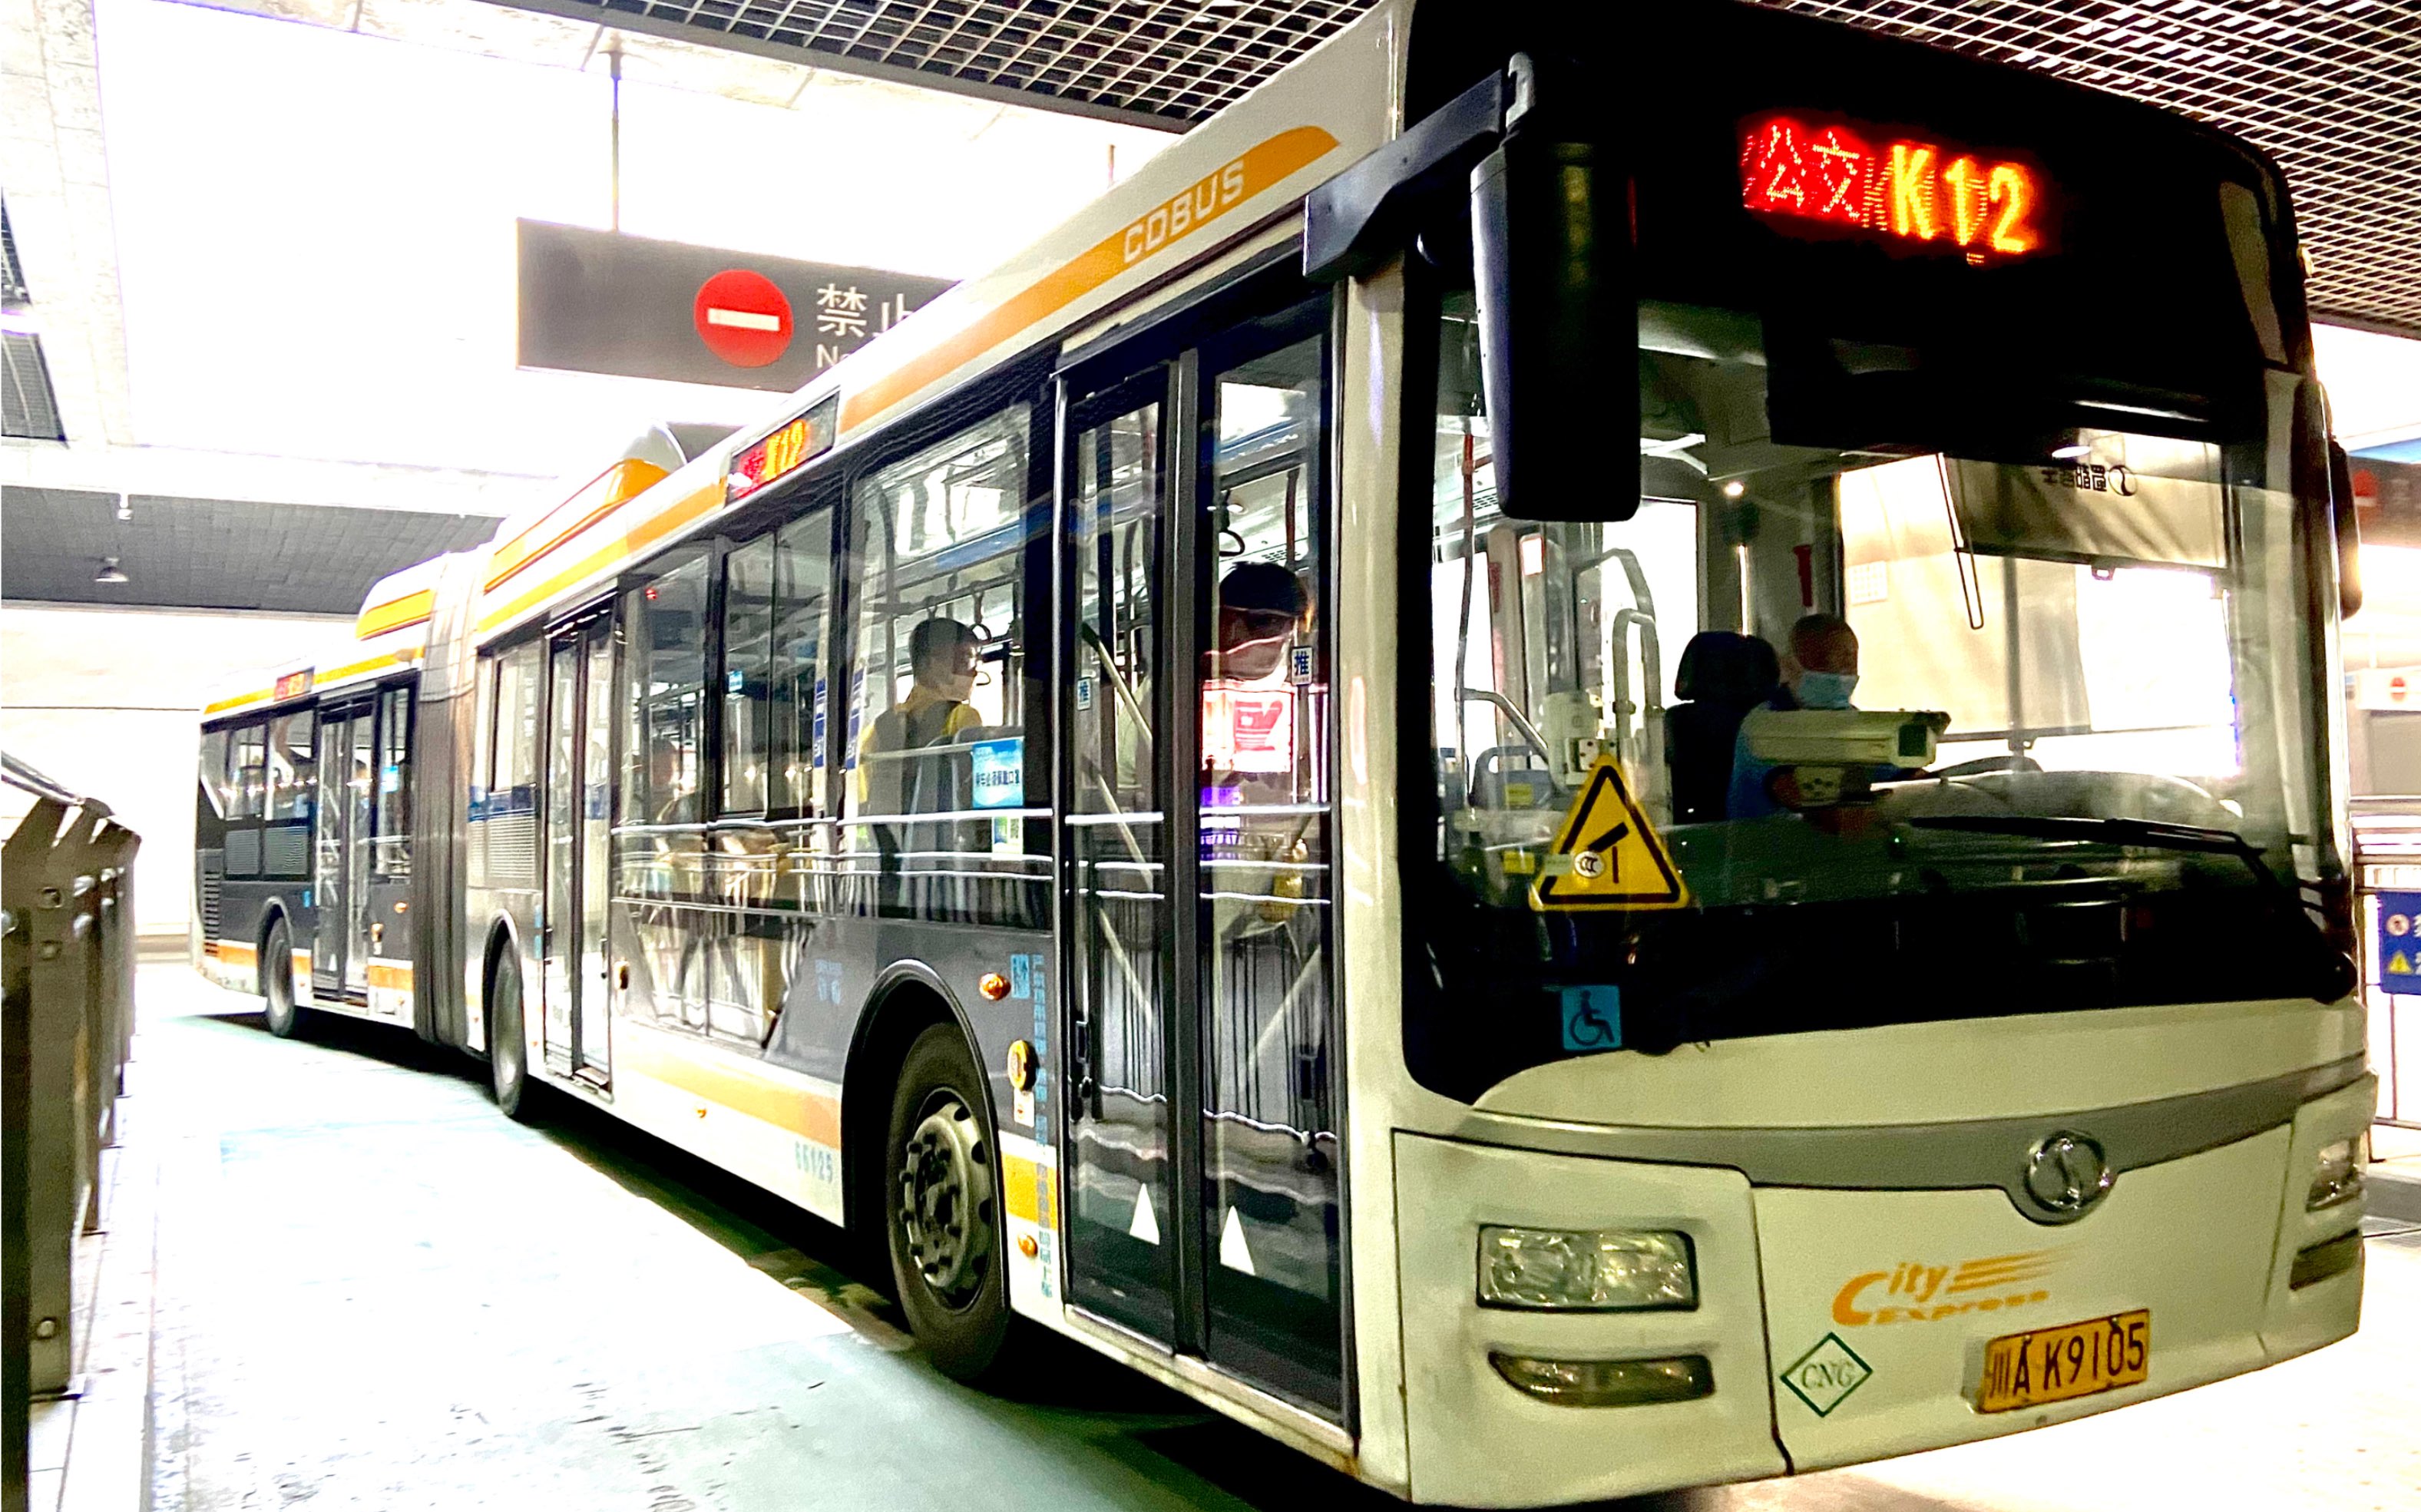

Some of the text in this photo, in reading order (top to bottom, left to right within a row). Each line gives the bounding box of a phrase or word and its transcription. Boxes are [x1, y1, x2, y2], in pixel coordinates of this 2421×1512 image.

[1124, 159, 1244, 256] COBUS
[816, 343, 850, 369] N
[1294, 650, 1310, 677] 推
[1832, 1262, 1949, 1325] City
[1801, 1359, 1855, 1389] CNG
